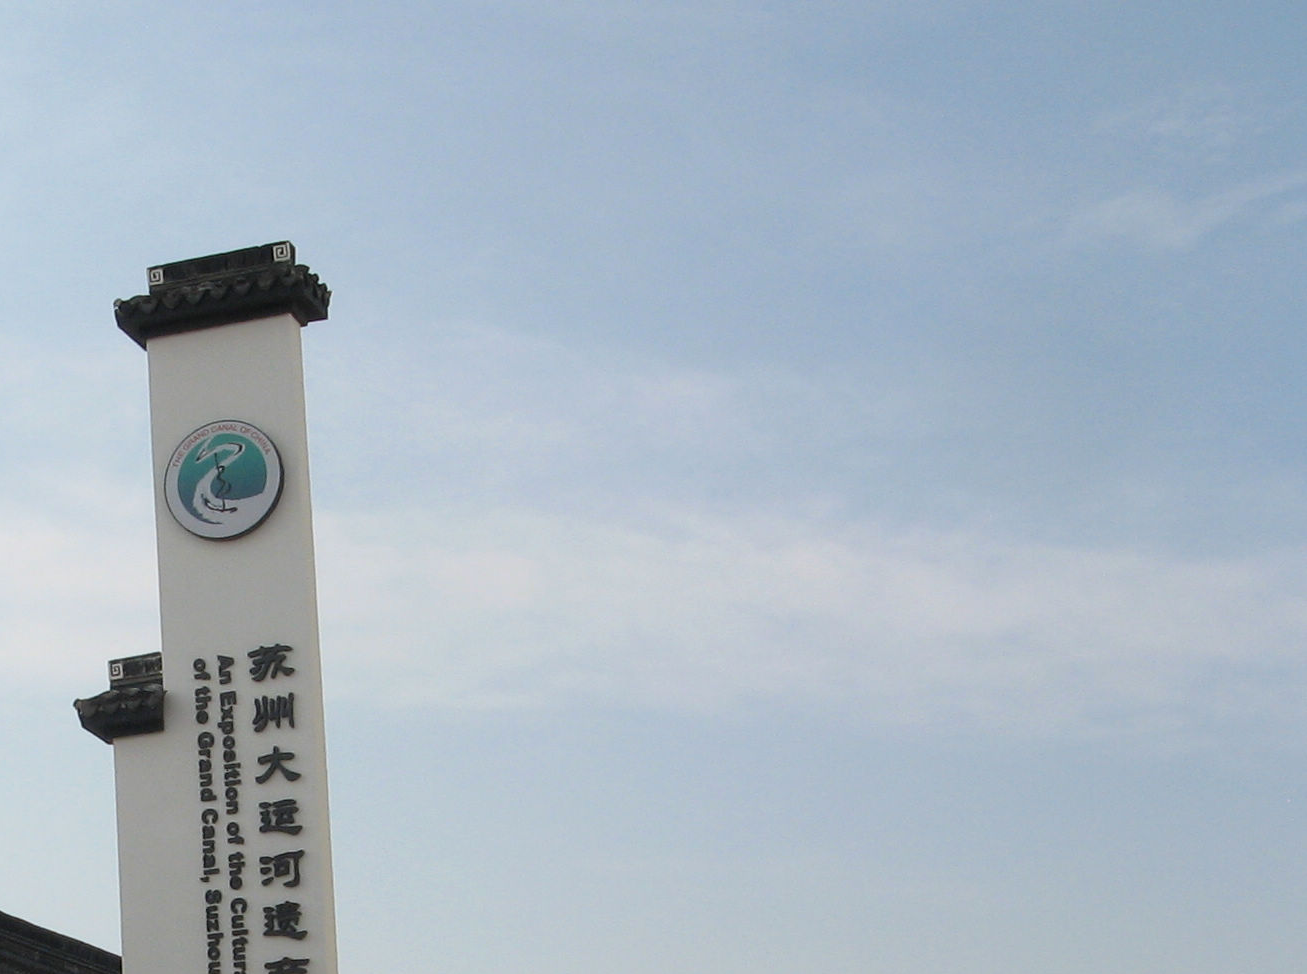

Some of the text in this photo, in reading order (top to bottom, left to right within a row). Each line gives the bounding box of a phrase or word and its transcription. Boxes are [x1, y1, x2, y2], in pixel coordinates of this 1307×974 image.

[211, 424, 238, 433] CANAL
[193, 658, 211, 680] of
[217, 655, 235, 685] An
[195, 686, 212, 724] the
[198, 732, 217, 802] Grand
[218, 691, 242, 815] Exposition
[200, 808, 220, 882] Canal,
[227, 822, 244, 845] of
[228, 852, 245, 890] the
